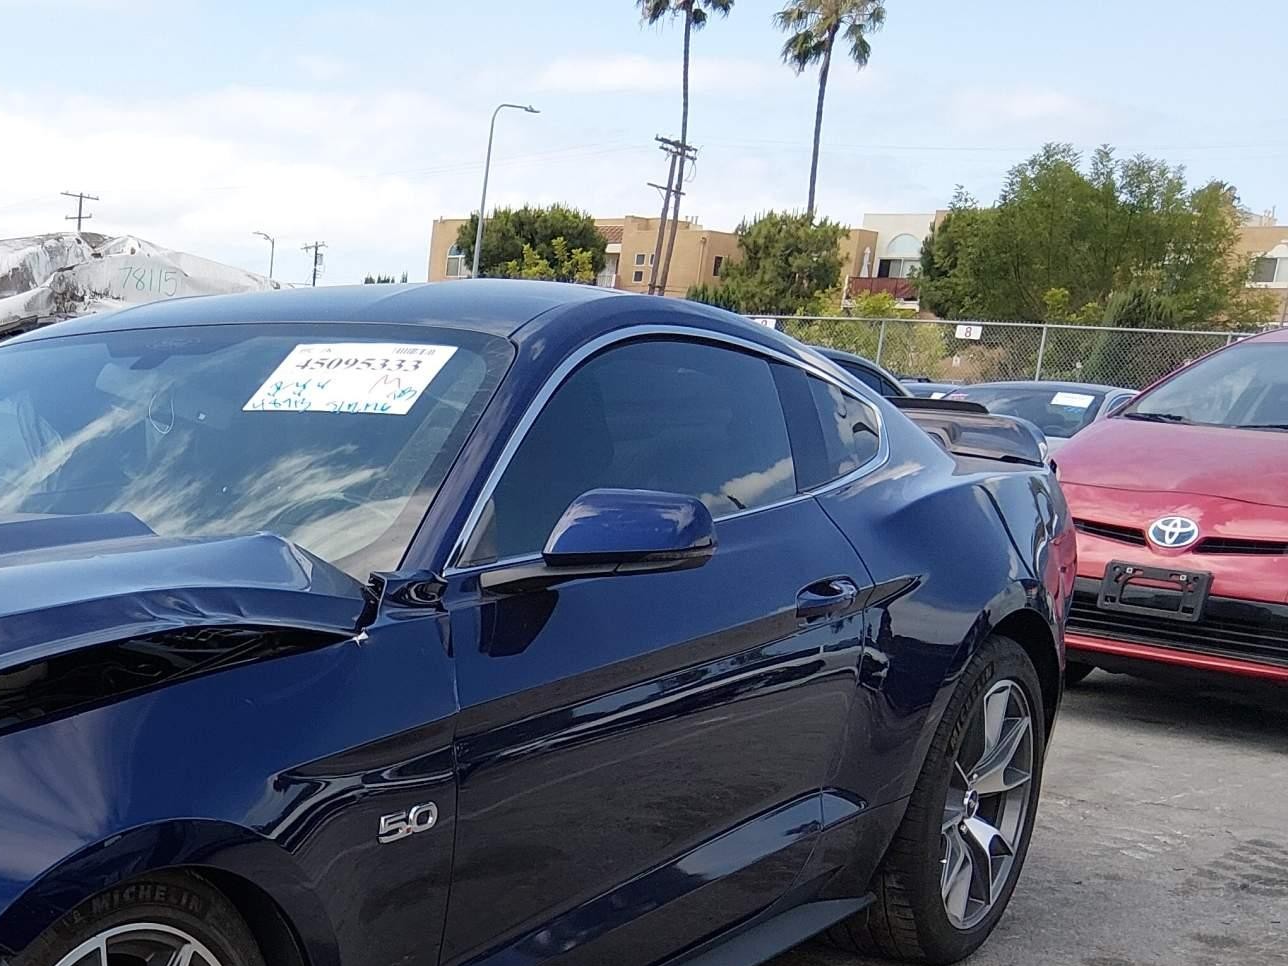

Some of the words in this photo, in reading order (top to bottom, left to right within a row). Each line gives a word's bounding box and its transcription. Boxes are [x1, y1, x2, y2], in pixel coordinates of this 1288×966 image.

[120, 266, 178, 297] 78115
[964, 326, 972, 338] 8
[296, 358, 423, 372] 45095333
